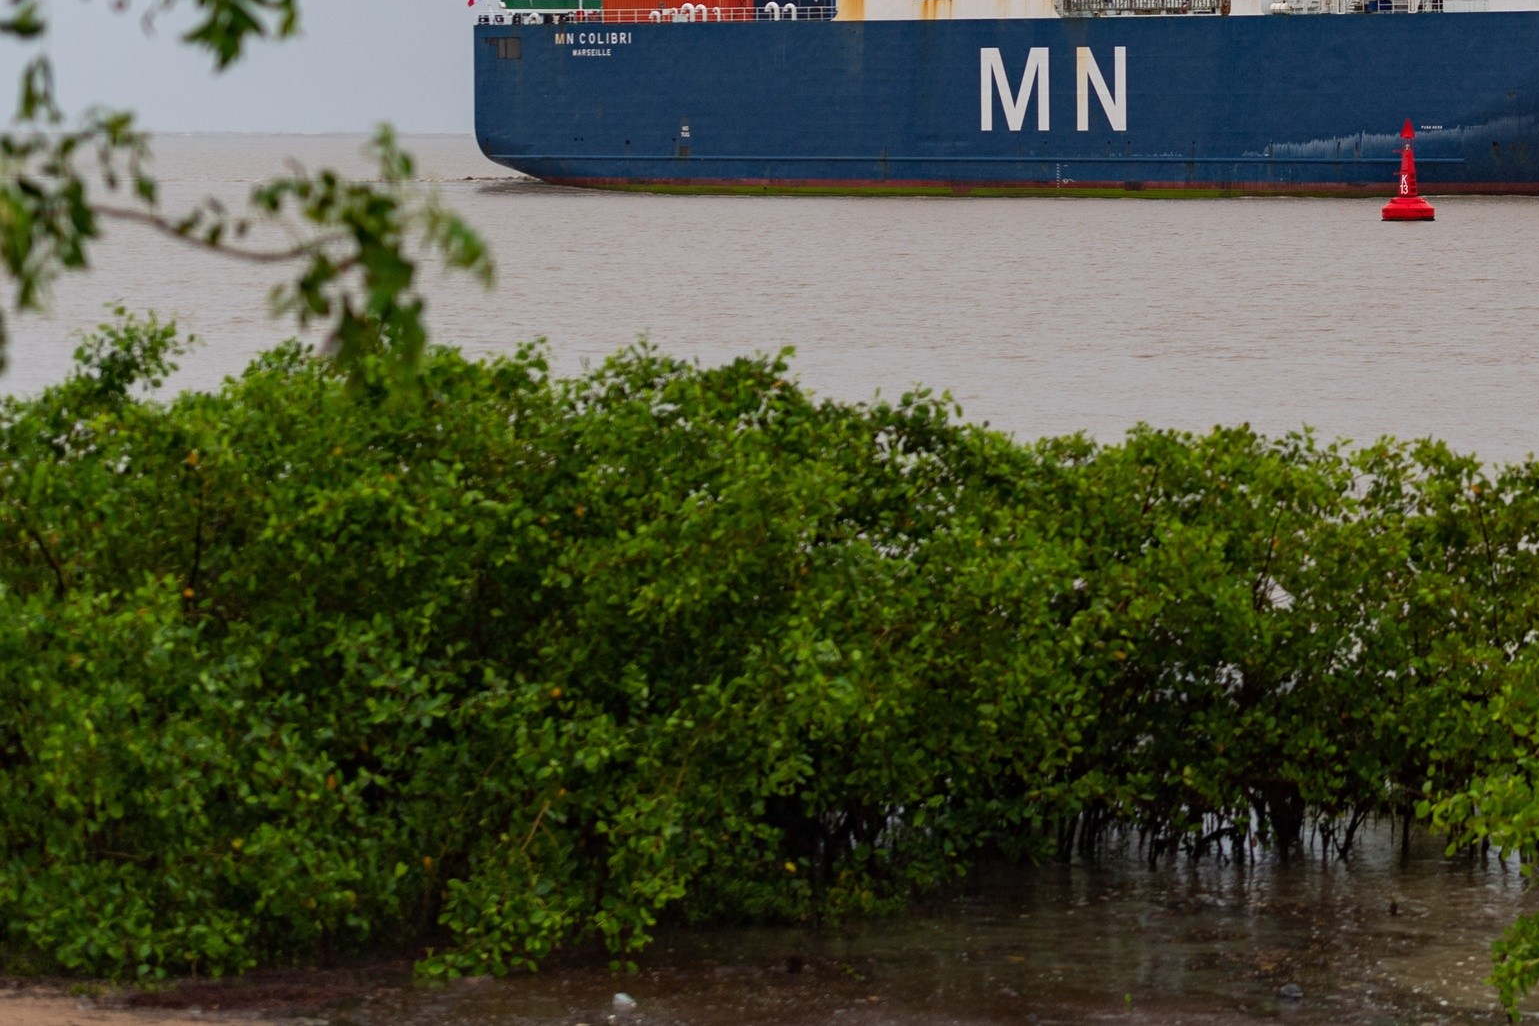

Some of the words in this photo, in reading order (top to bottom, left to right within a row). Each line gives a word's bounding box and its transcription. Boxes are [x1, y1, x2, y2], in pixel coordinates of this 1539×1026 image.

[555, 33, 574, 45] MN
[579, 32, 631, 44] COLIBRI
[1402, 174, 1408, 184] K
[1400, 184, 1409, 194] 13
